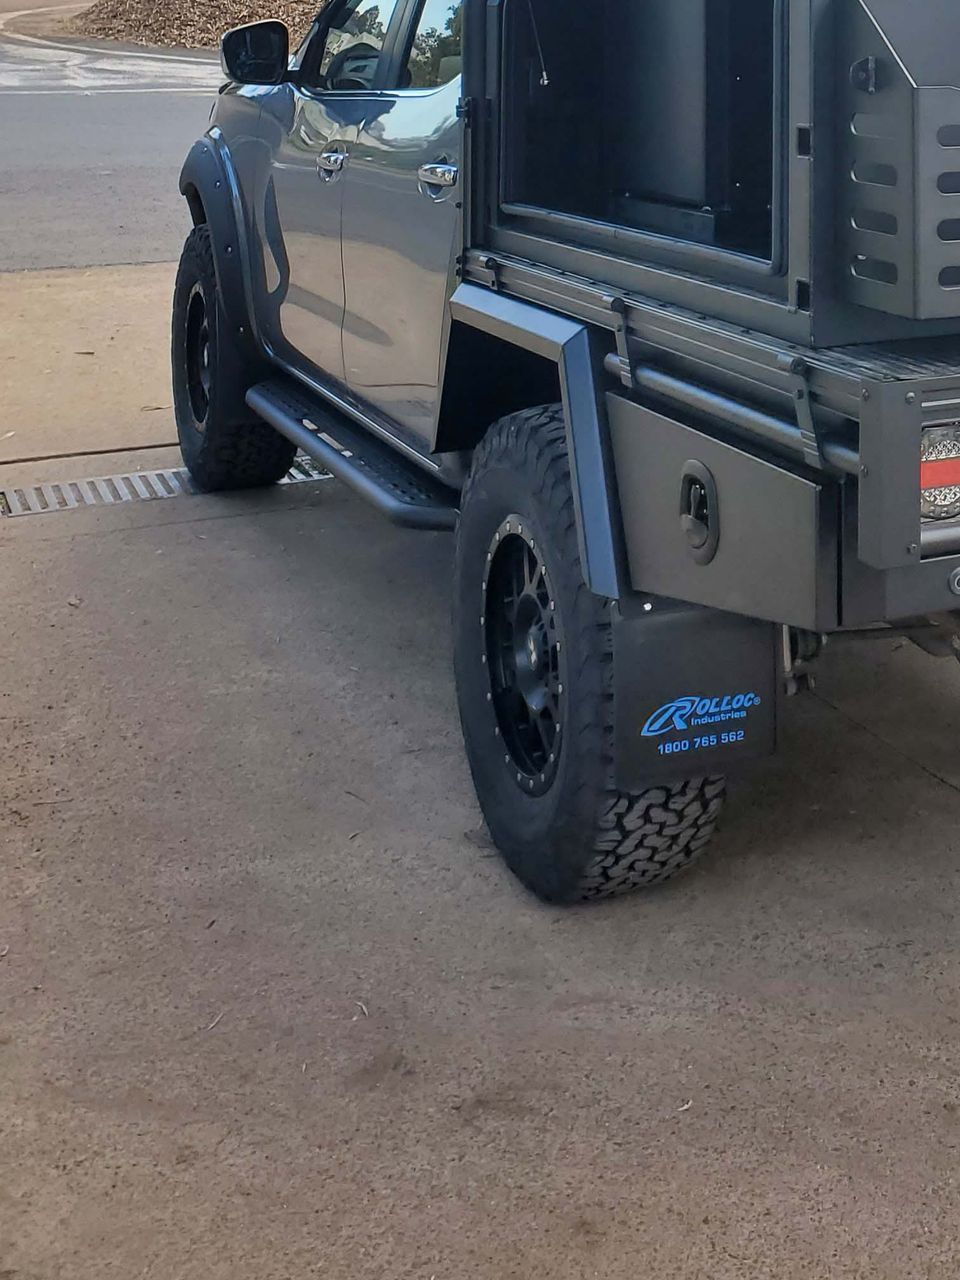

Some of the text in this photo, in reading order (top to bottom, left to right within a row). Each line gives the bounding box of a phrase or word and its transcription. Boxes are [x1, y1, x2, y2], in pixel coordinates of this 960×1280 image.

[691, 710, 747, 726] Industries
[658, 730, 745, 755] 1800 765 562
